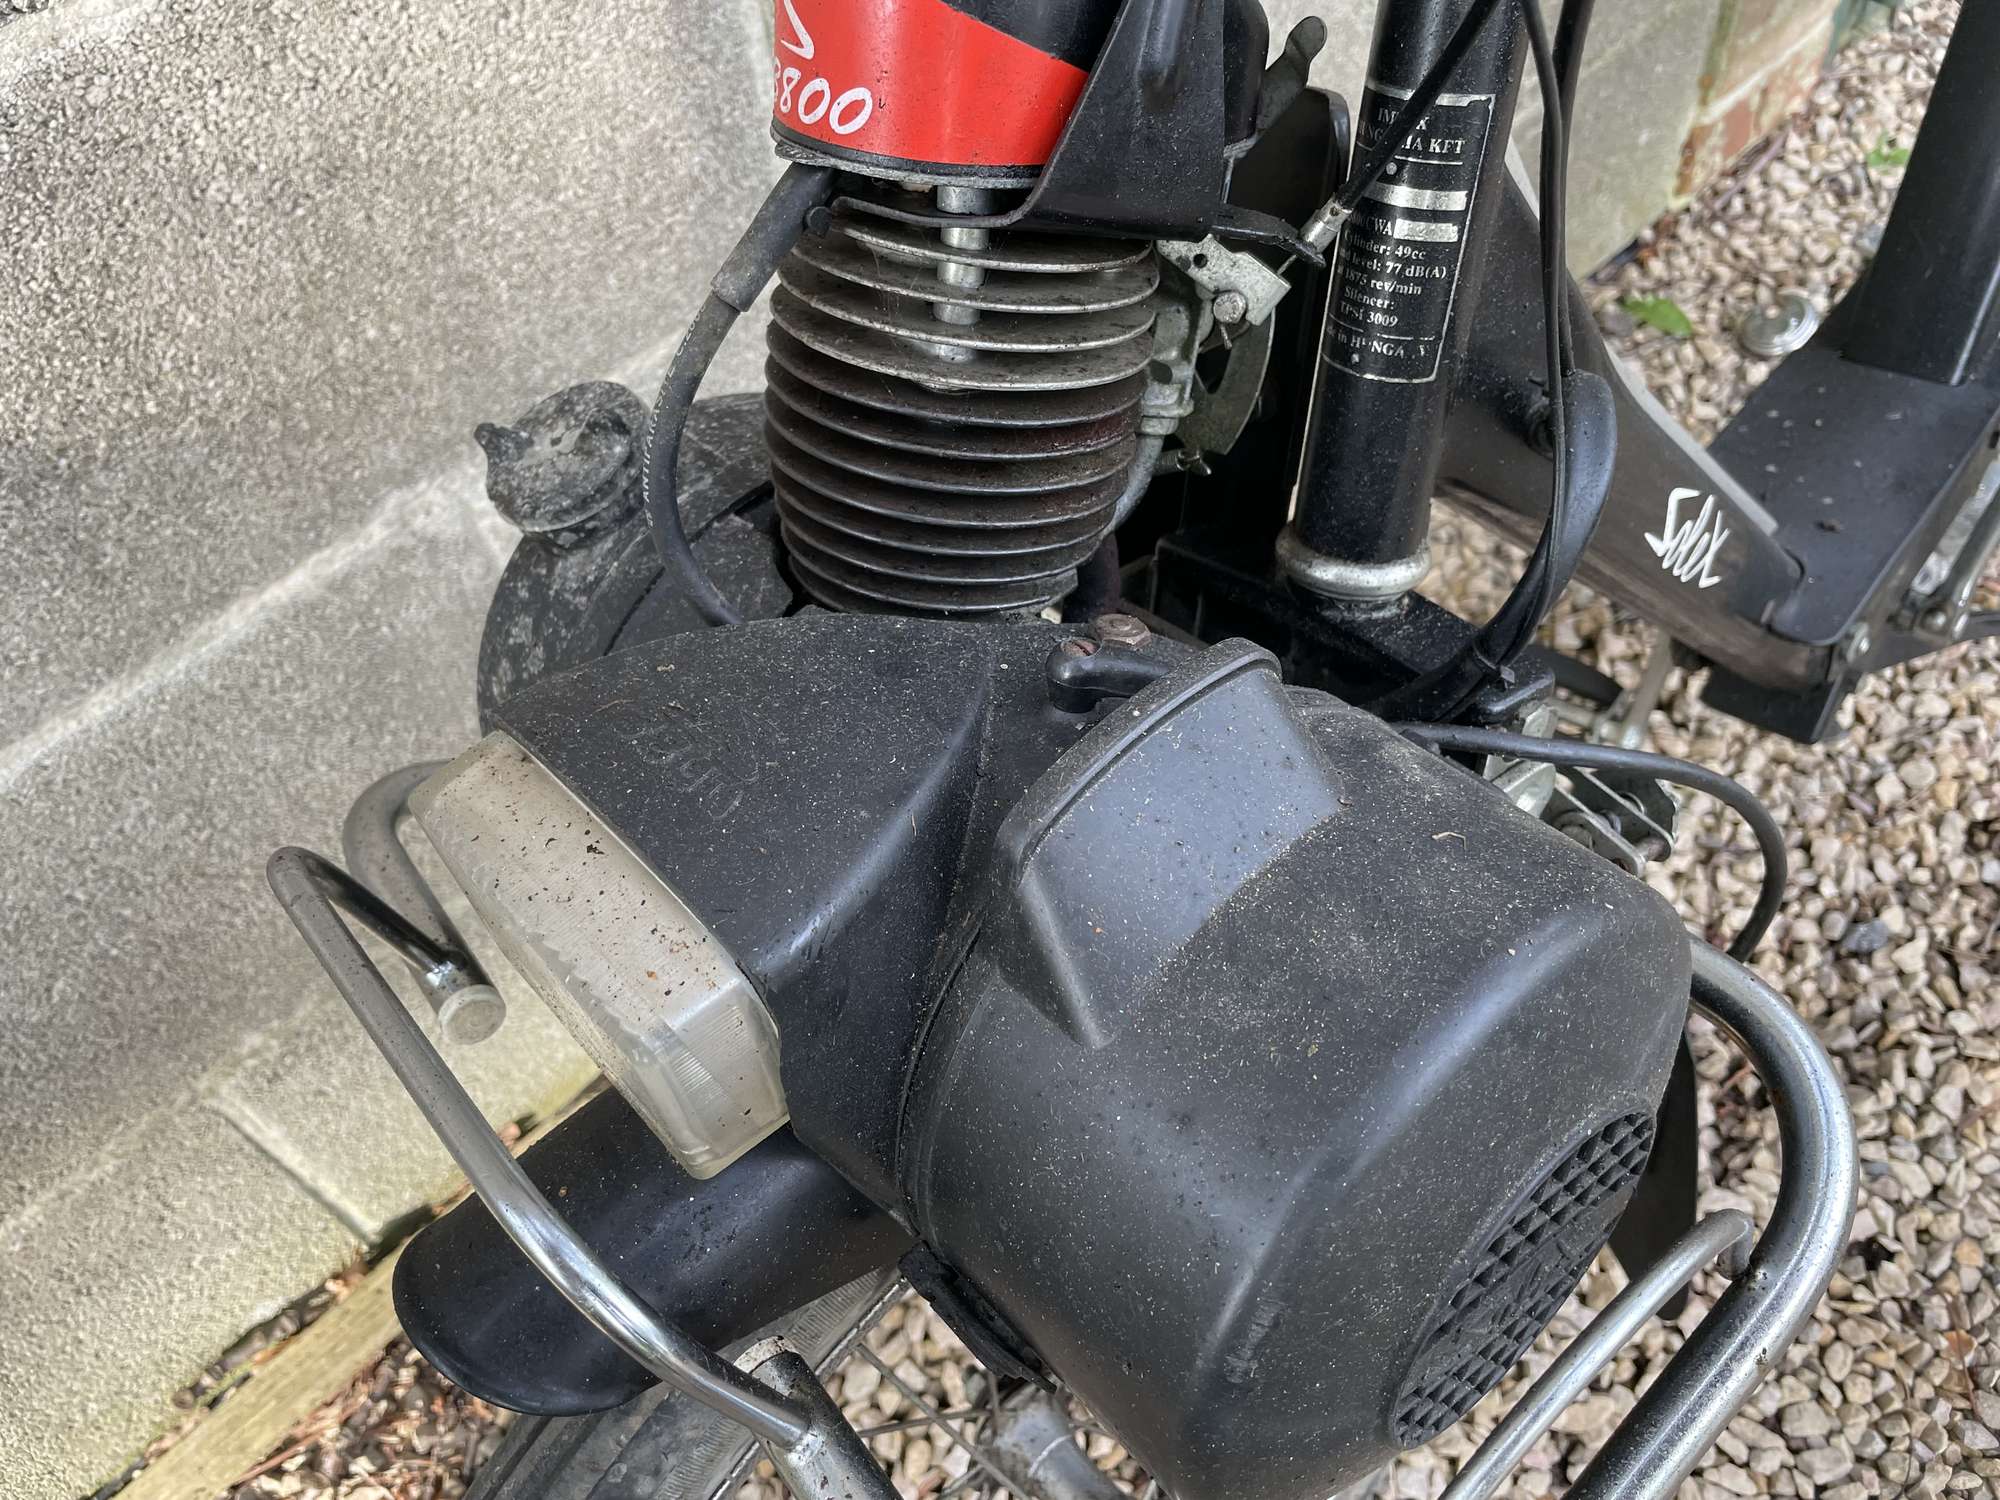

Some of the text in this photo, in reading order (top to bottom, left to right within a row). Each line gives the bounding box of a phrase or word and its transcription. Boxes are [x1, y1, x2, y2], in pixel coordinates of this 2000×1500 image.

[1428, 137, 1466, 154] KFT
[1394, 244, 1427, 260] 49cc
[1385, 260, 1401, 275] 77
[1405, 266, 1447, 279] dB(A)
[1370, 279, 1422, 296] rev/min
[1344, 285, 1395, 310] Silencer:
[1366, 311, 1398, 327] 3009
[1644, 487, 1731, 589] Solex
